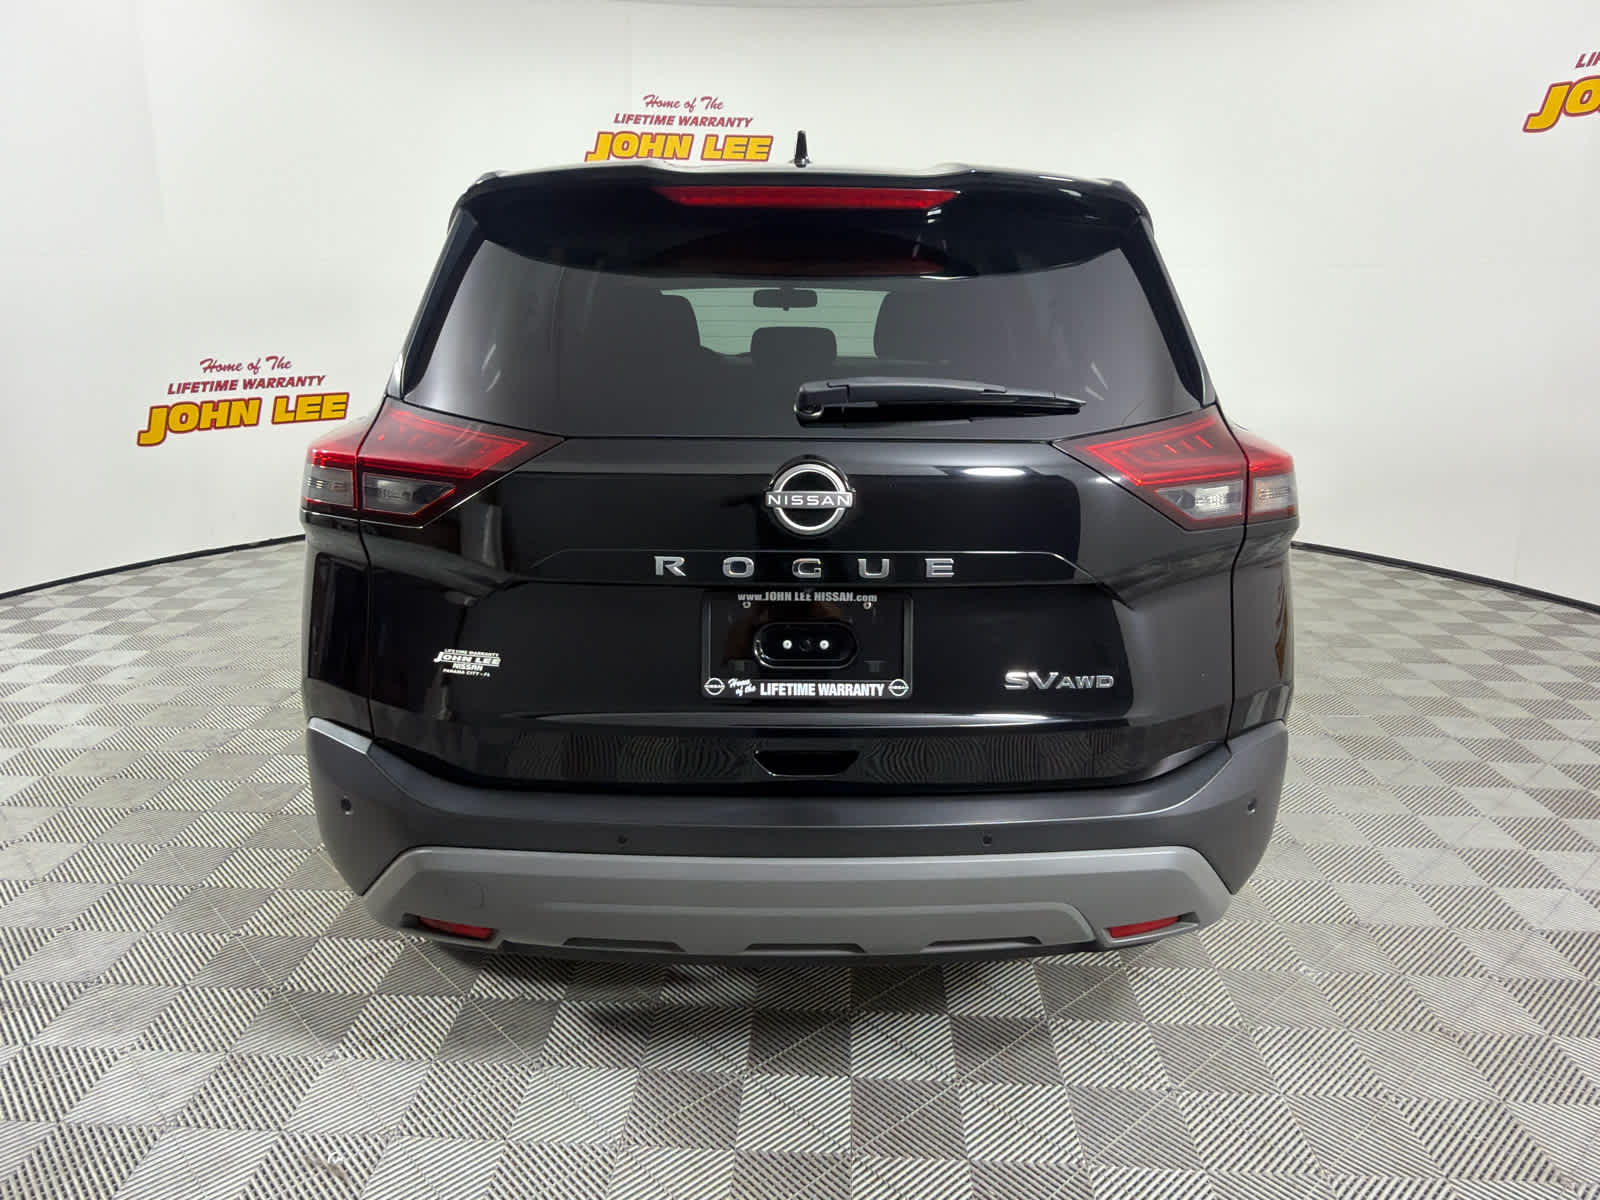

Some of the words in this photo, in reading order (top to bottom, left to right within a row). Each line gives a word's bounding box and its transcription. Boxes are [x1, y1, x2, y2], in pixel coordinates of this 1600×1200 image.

[643, 94, 680, 109] Home
[684, 97, 697, 113] of
[700, 96, 724, 110] The
[613, 113, 675, 126] LIFETIME
[678, 115, 753, 128] WARRANTY
[584, 131, 694, 162] JOHN
[701, 134, 774, 161] LEE
[200, 358, 243, 373] Home
[247, 358, 261, 374] of
[266, 356, 292, 370] The
[168, 379, 239, 395] LIFETIME
[242, 375, 326, 390] WARRANTY
[137, 397, 262, 447] JOHN
[272, 392, 349, 424] LEE
[767, 494, 852, 507] NISSAN
[654, 556, 955, 579] ROGUE
[433, 652, 473, 663] JOHN
[475, 657, 501, 666] LEE
[760, 683, 815, 696] LIFETIME
[818, 683, 885, 697] WARRANTY
[1004, 671, 1059, 690] SV
[1056, 675, 1114, 689] AWD
